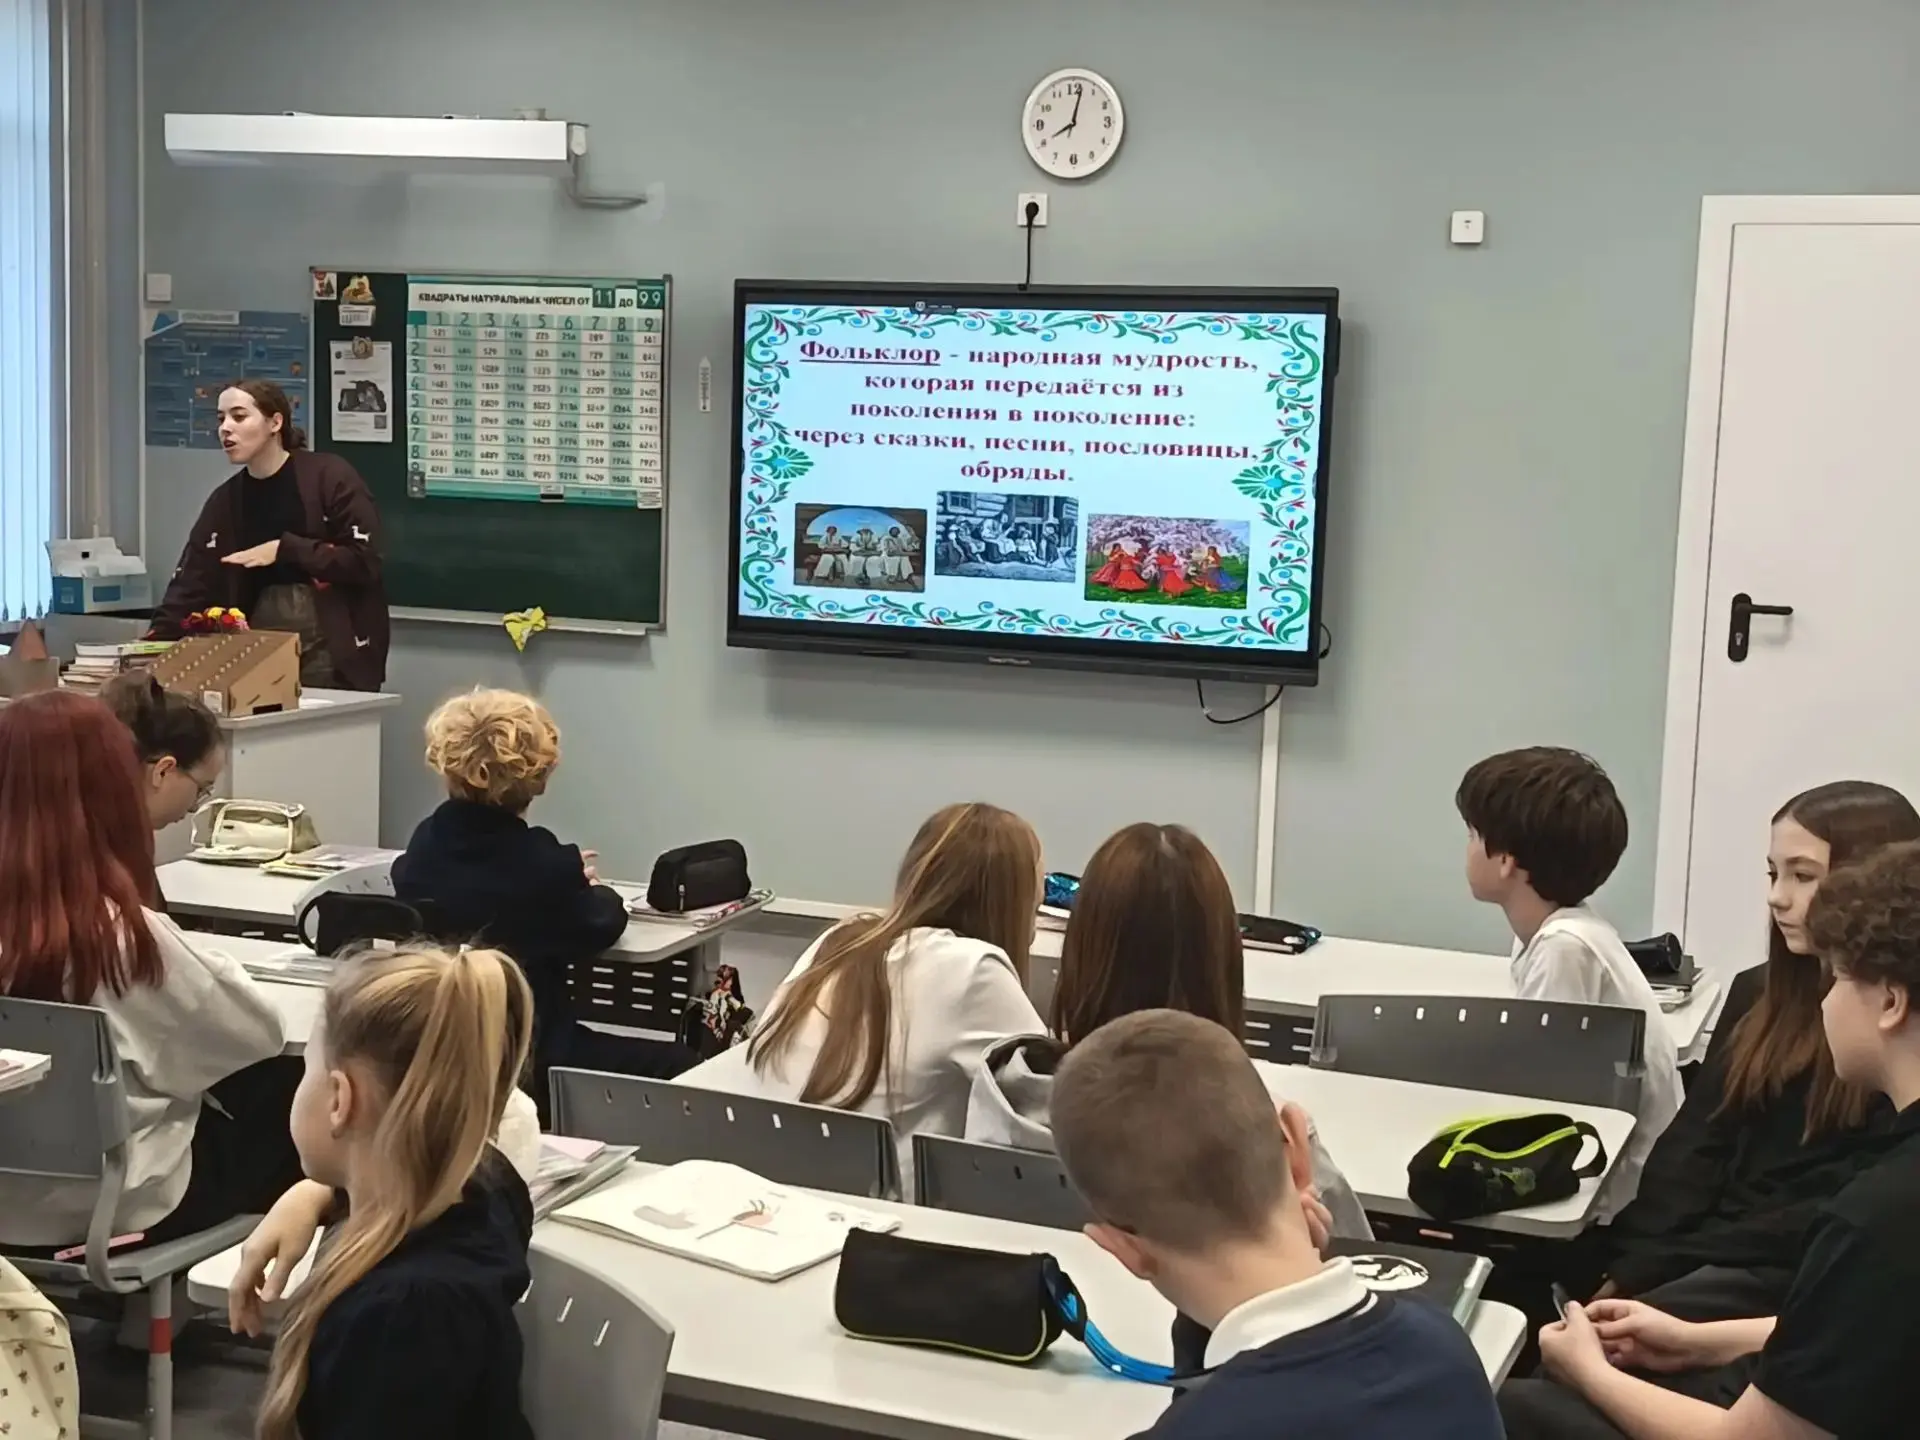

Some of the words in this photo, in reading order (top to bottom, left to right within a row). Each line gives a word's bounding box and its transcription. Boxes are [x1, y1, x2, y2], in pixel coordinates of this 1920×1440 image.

[1067, 83, 1082, 95] 12
[1041, 104, 1052, 112] 10
[1103, 116, 1111, 128] 3
[418, 292, 469, 303] КВАДРАТЫ
[471, 293, 541, 304] НАТУРАЛЬНЫХ
[543, 296, 576, 306] ЧИСЕЛ
[577, 297, 590, 306] ОТ
[594, 288, 613, 306] 11
[619, 298, 634, 308] ДО
[639, 290, 661, 307] 99
[436, 312, 442, 326] 1
[460, 312, 470, 326] 2
[485, 312, 495, 327] 3
[512, 313, 520, 327] 4
[538, 314, 546, 328] 5
[564, 315, 573, 330] 6
[592, 316, 600, 330] 7
[618, 317, 626, 332] 8
[644, 317, 654, 332] 9
[414, 325, 419, 338] 1
[411, 341, 420, 356] 2
[800, 341, 941, 366] Фольклор
[968, 350, 1101, 368] народная
[1112, 352, 1258, 372] мудрость,
[411, 358, 420, 373] 3
[411, 375, 419, 390] 4
[865, 375, 974, 394] которая
[985, 379, 1142, 397] передаётся
[1153, 383, 1183, 397] из
[411, 393, 420, 408] 5
[410, 410, 420, 425] 6
[850, 403, 997, 420] поколения
[1008, 409, 1023, 421] в
[1033, 409, 1195, 427] поколение:
[410, 427, 420, 442] 7
[411, 445, 420, 459] 8
[794, 429, 865, 447] через
[874, 436, 975, 450] сказки,
[984, 437, 1074, 454] песни,
[1085, 440, 1258, 461] пословицы,
[960, 460, 1074, 483] обряды.
